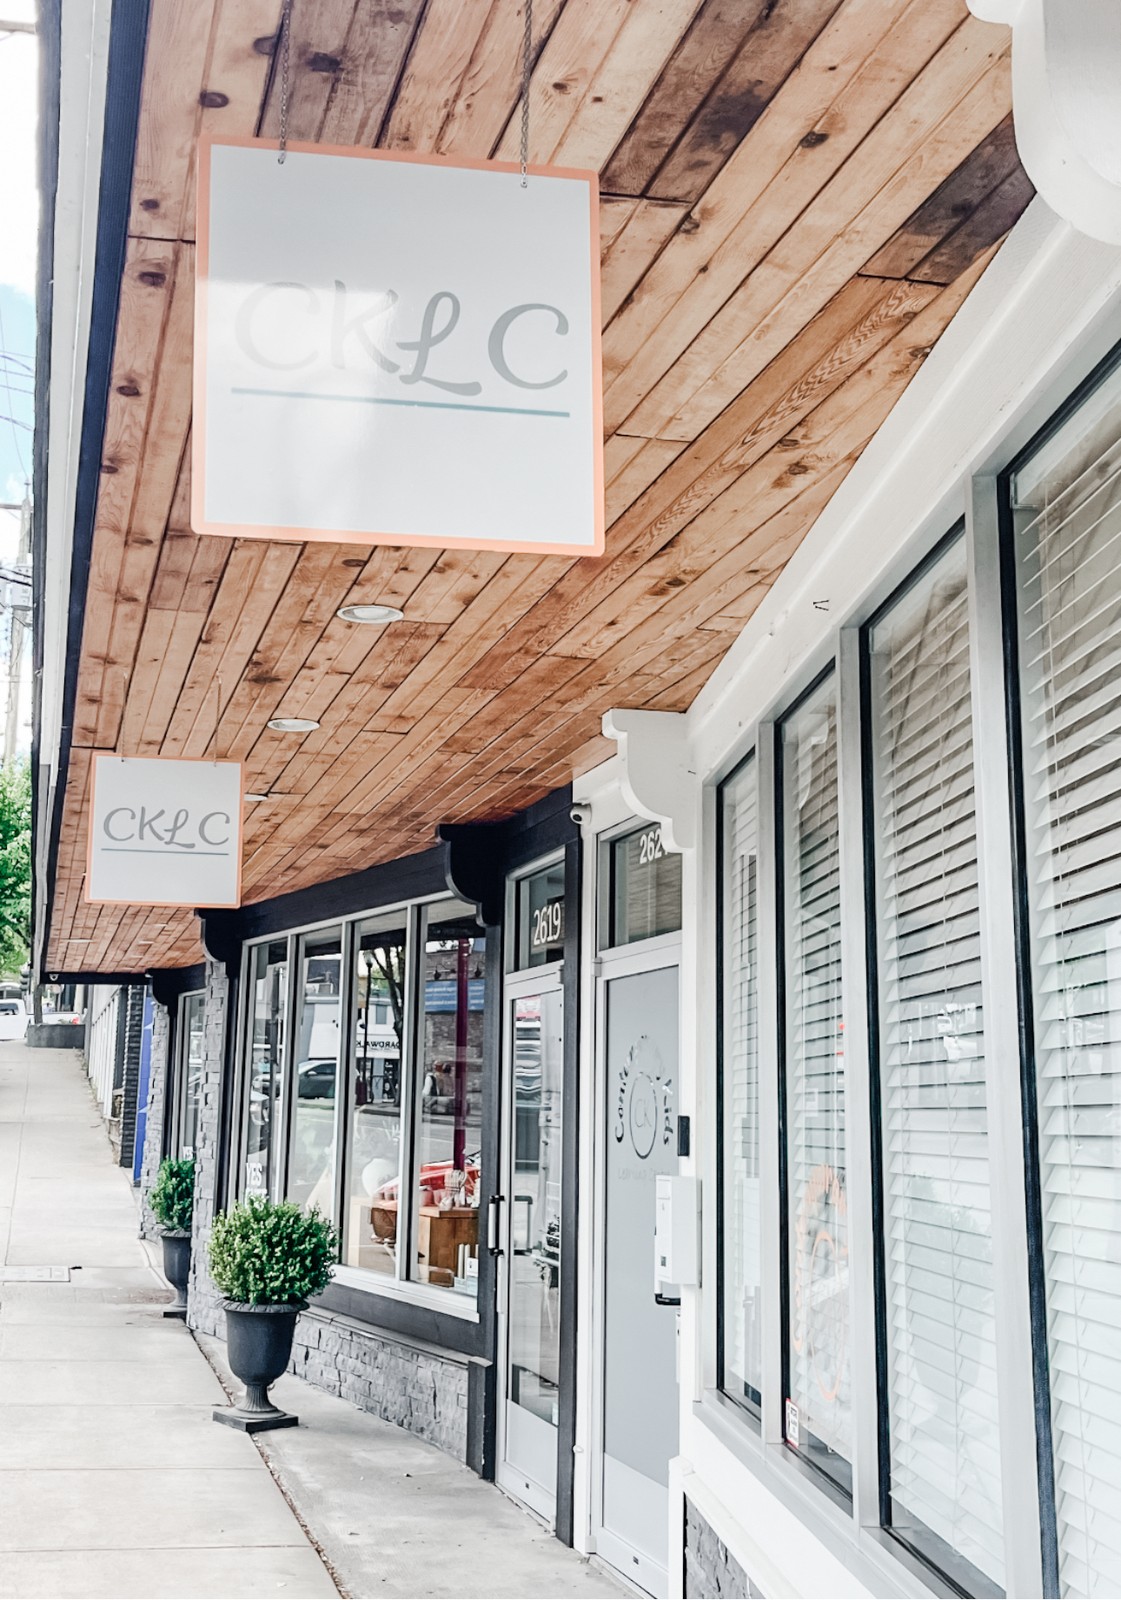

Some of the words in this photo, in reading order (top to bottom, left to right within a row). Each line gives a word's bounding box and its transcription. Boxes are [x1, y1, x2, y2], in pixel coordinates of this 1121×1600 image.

[234, 279, 570, 396] CKLC
[103, 806, 230, 849] CKLC
[639, 828, 669, 865] 262
[533, 902, 561, 946] 2619
